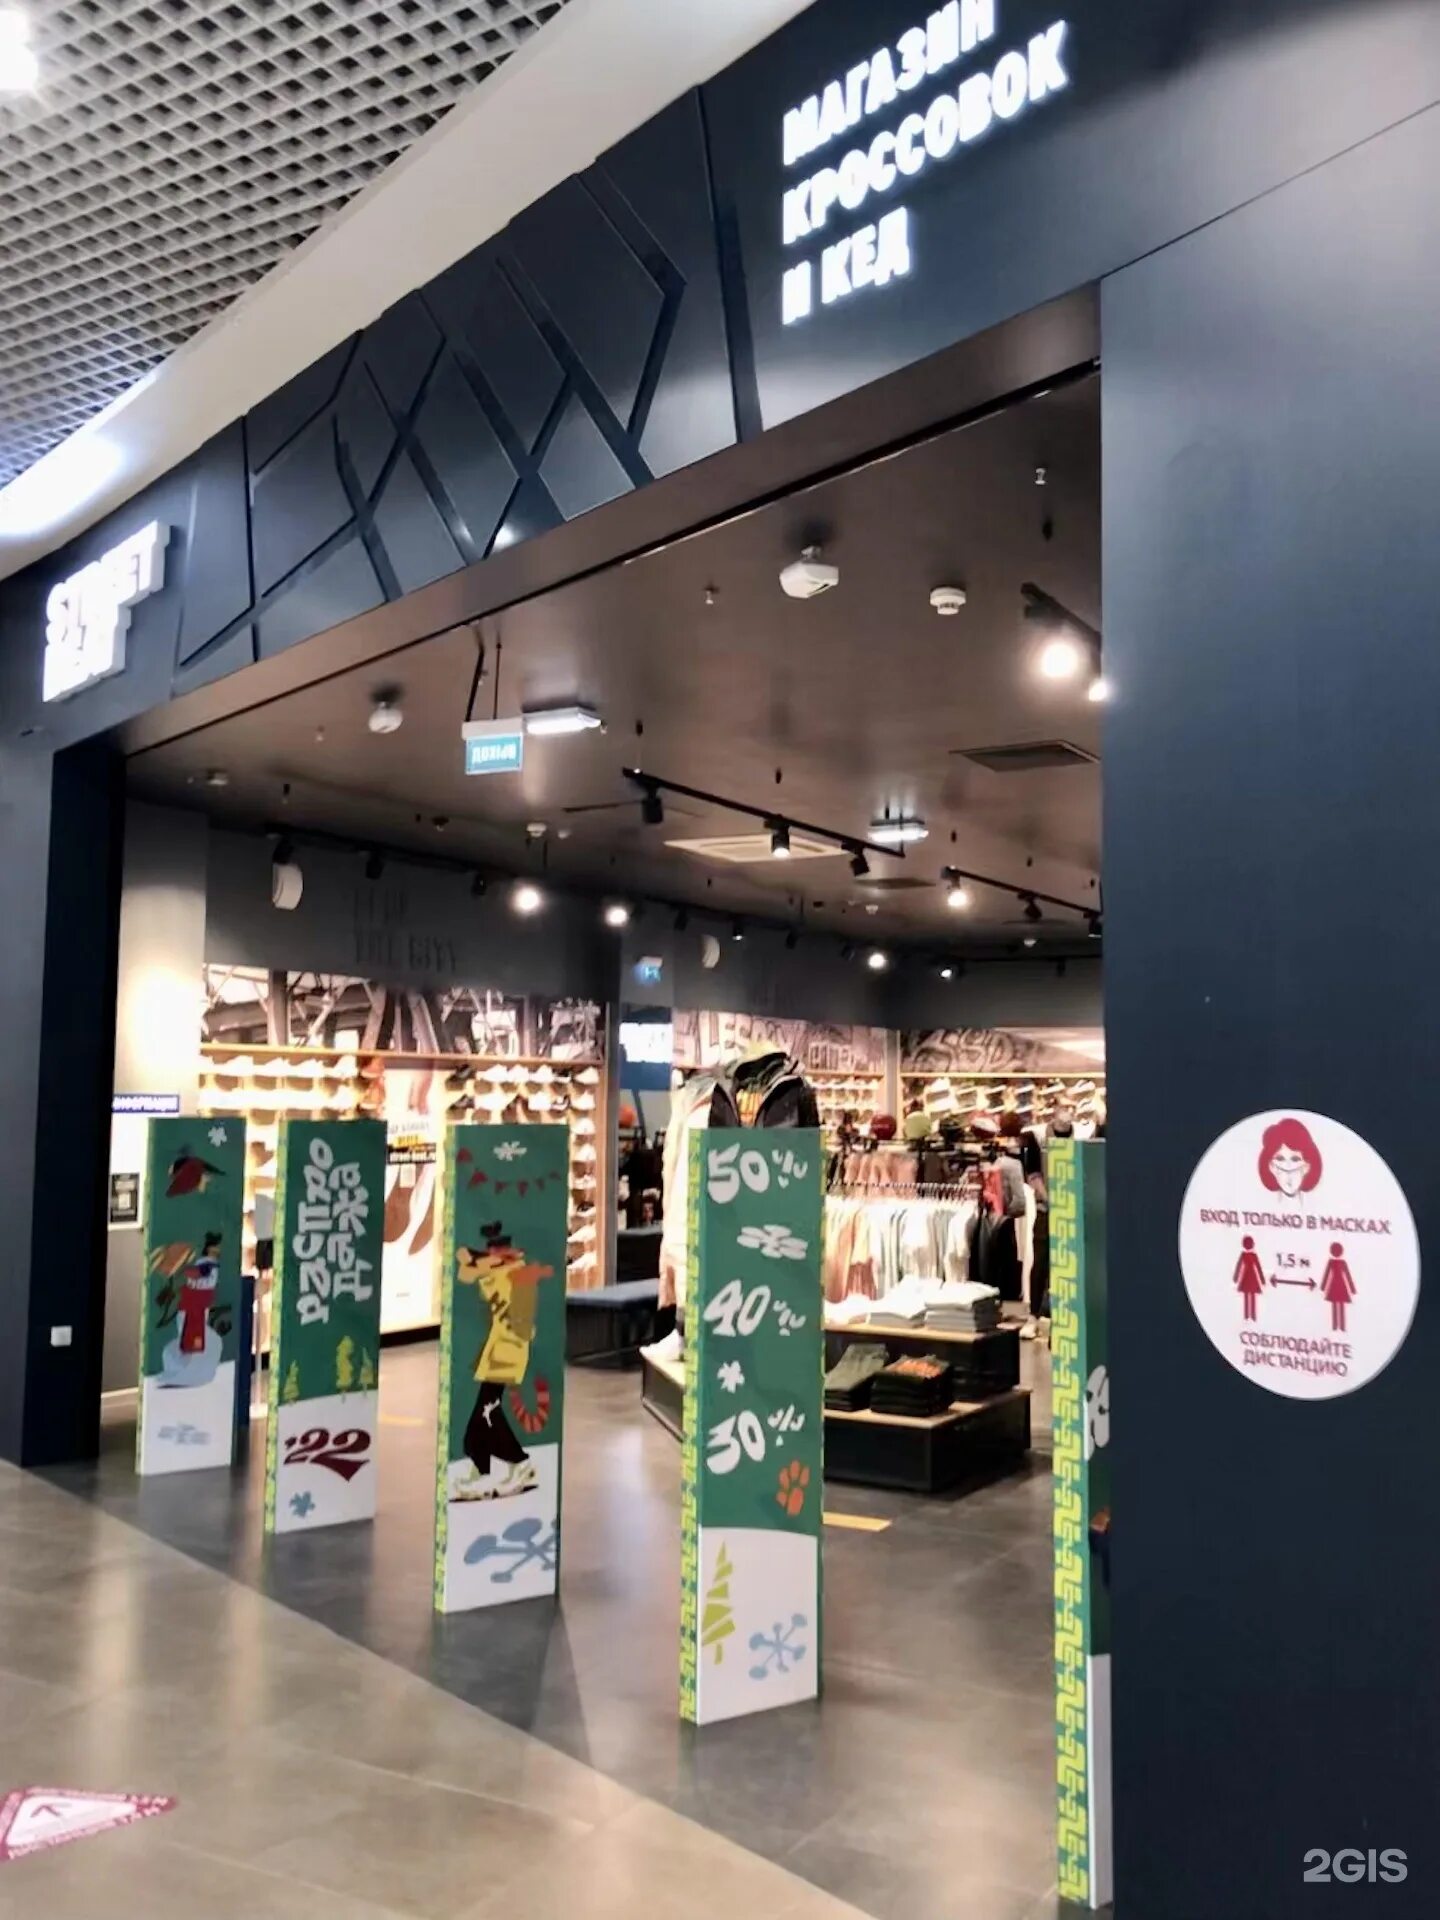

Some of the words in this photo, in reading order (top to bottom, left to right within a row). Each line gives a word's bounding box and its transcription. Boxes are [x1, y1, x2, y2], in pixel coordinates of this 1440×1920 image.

[783, 0, 995, 166] МАГАЗИН
[782, 20, 1069, 245] КРОССОВОК
[781, 260, 811, 326] И
[821, 206, 911, 305] КЕД
[1199, 1208, 1240, 1227] ВХОД
[1242, 1211, 1303, 1229] ТОЛЬКО
[1306, 1216, 1317, 1230] В
[1319, 1217, 1391, 1235] МАСКАХ
[1276, 1252, 1297, 1269] 1,5
[1239, 1331, 1352, 1359] СОБЛЮДАЙТЕ
[1243, 1349, 1349, 1377] ДИСТАНЦИЮ
